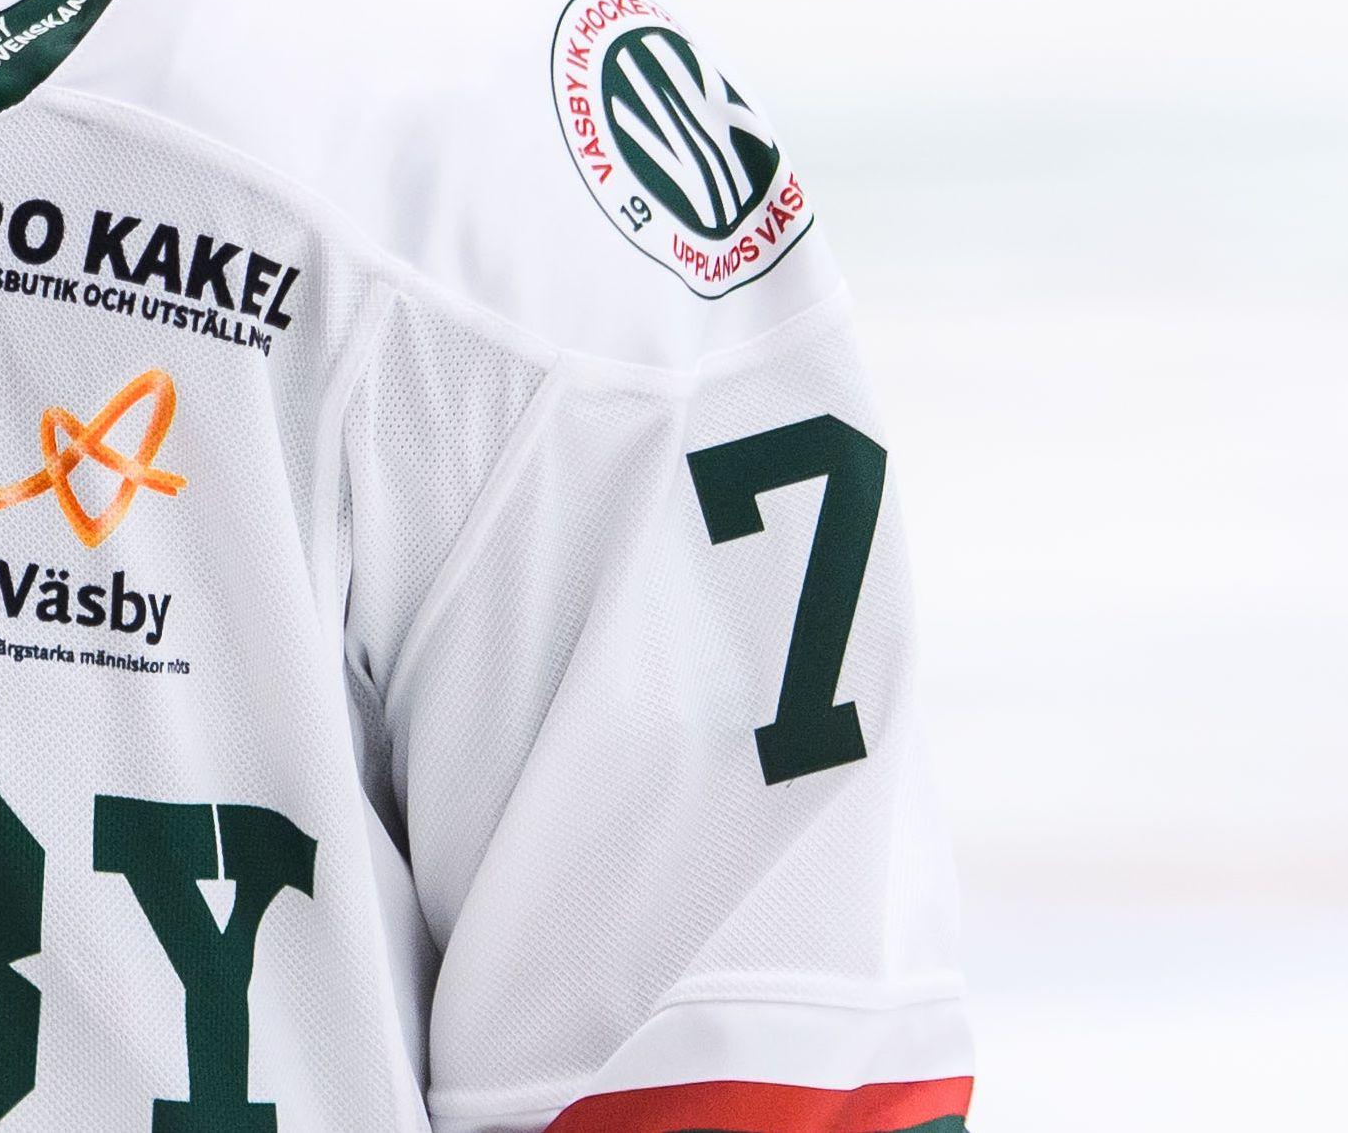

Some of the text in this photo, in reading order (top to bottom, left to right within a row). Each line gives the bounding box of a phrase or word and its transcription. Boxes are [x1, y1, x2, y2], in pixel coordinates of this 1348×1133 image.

[566, 72, 613, 184] VÄSBY
[620, 196, 653, 232] 19
[83, 210, 301, 331] KAKEL
[673, 233, 759, 282] UPPLANDS
[83, 284, 136, 317] OCH
[686, 413, 888, 787] 7
[80, 650, 164, 674] människor
